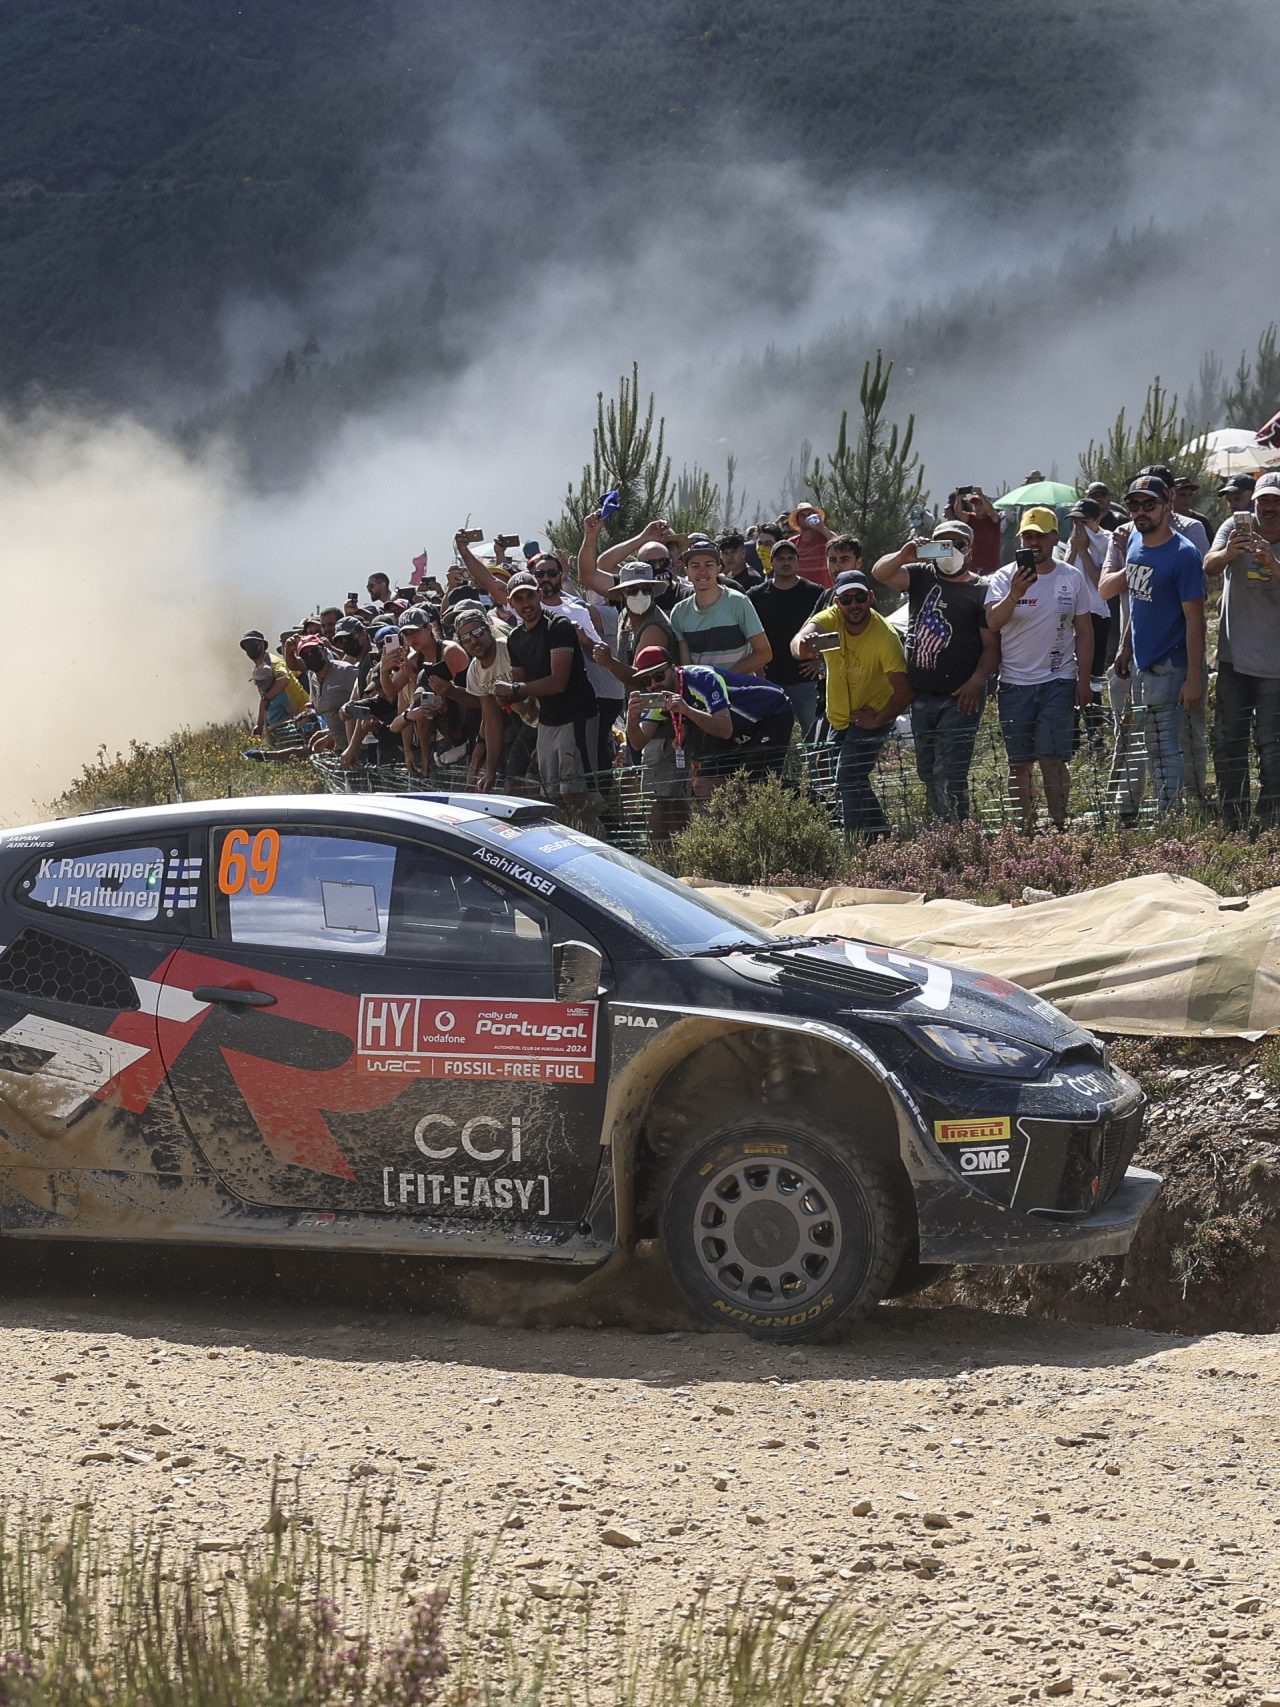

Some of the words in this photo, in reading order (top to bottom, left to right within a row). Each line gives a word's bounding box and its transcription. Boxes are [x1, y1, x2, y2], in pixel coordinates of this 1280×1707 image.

[6, 841, 55, 849] AIRLINES
[218, 828, 281, 895] 69
[472, 847, 557, 896] AsahiKASEI
[478, 1011, 503, 1020] rally
[614, 1014, 659, 1029] PIAA
[366, 1002, 411, 1047] HY
[475, 1019, 588, 1041] Portugal
[422, 1034, 466, 1044] vodafone
[566, 1045, 587, 1053] 2024
[444, 1061, 541, 1078] FOSSIL-FREE
[545, 1064, 584, 1079] FUEL
[942, 1122, 1004, 1139] PIRELLI
[960, 1150, 1010, 1170] OMP
